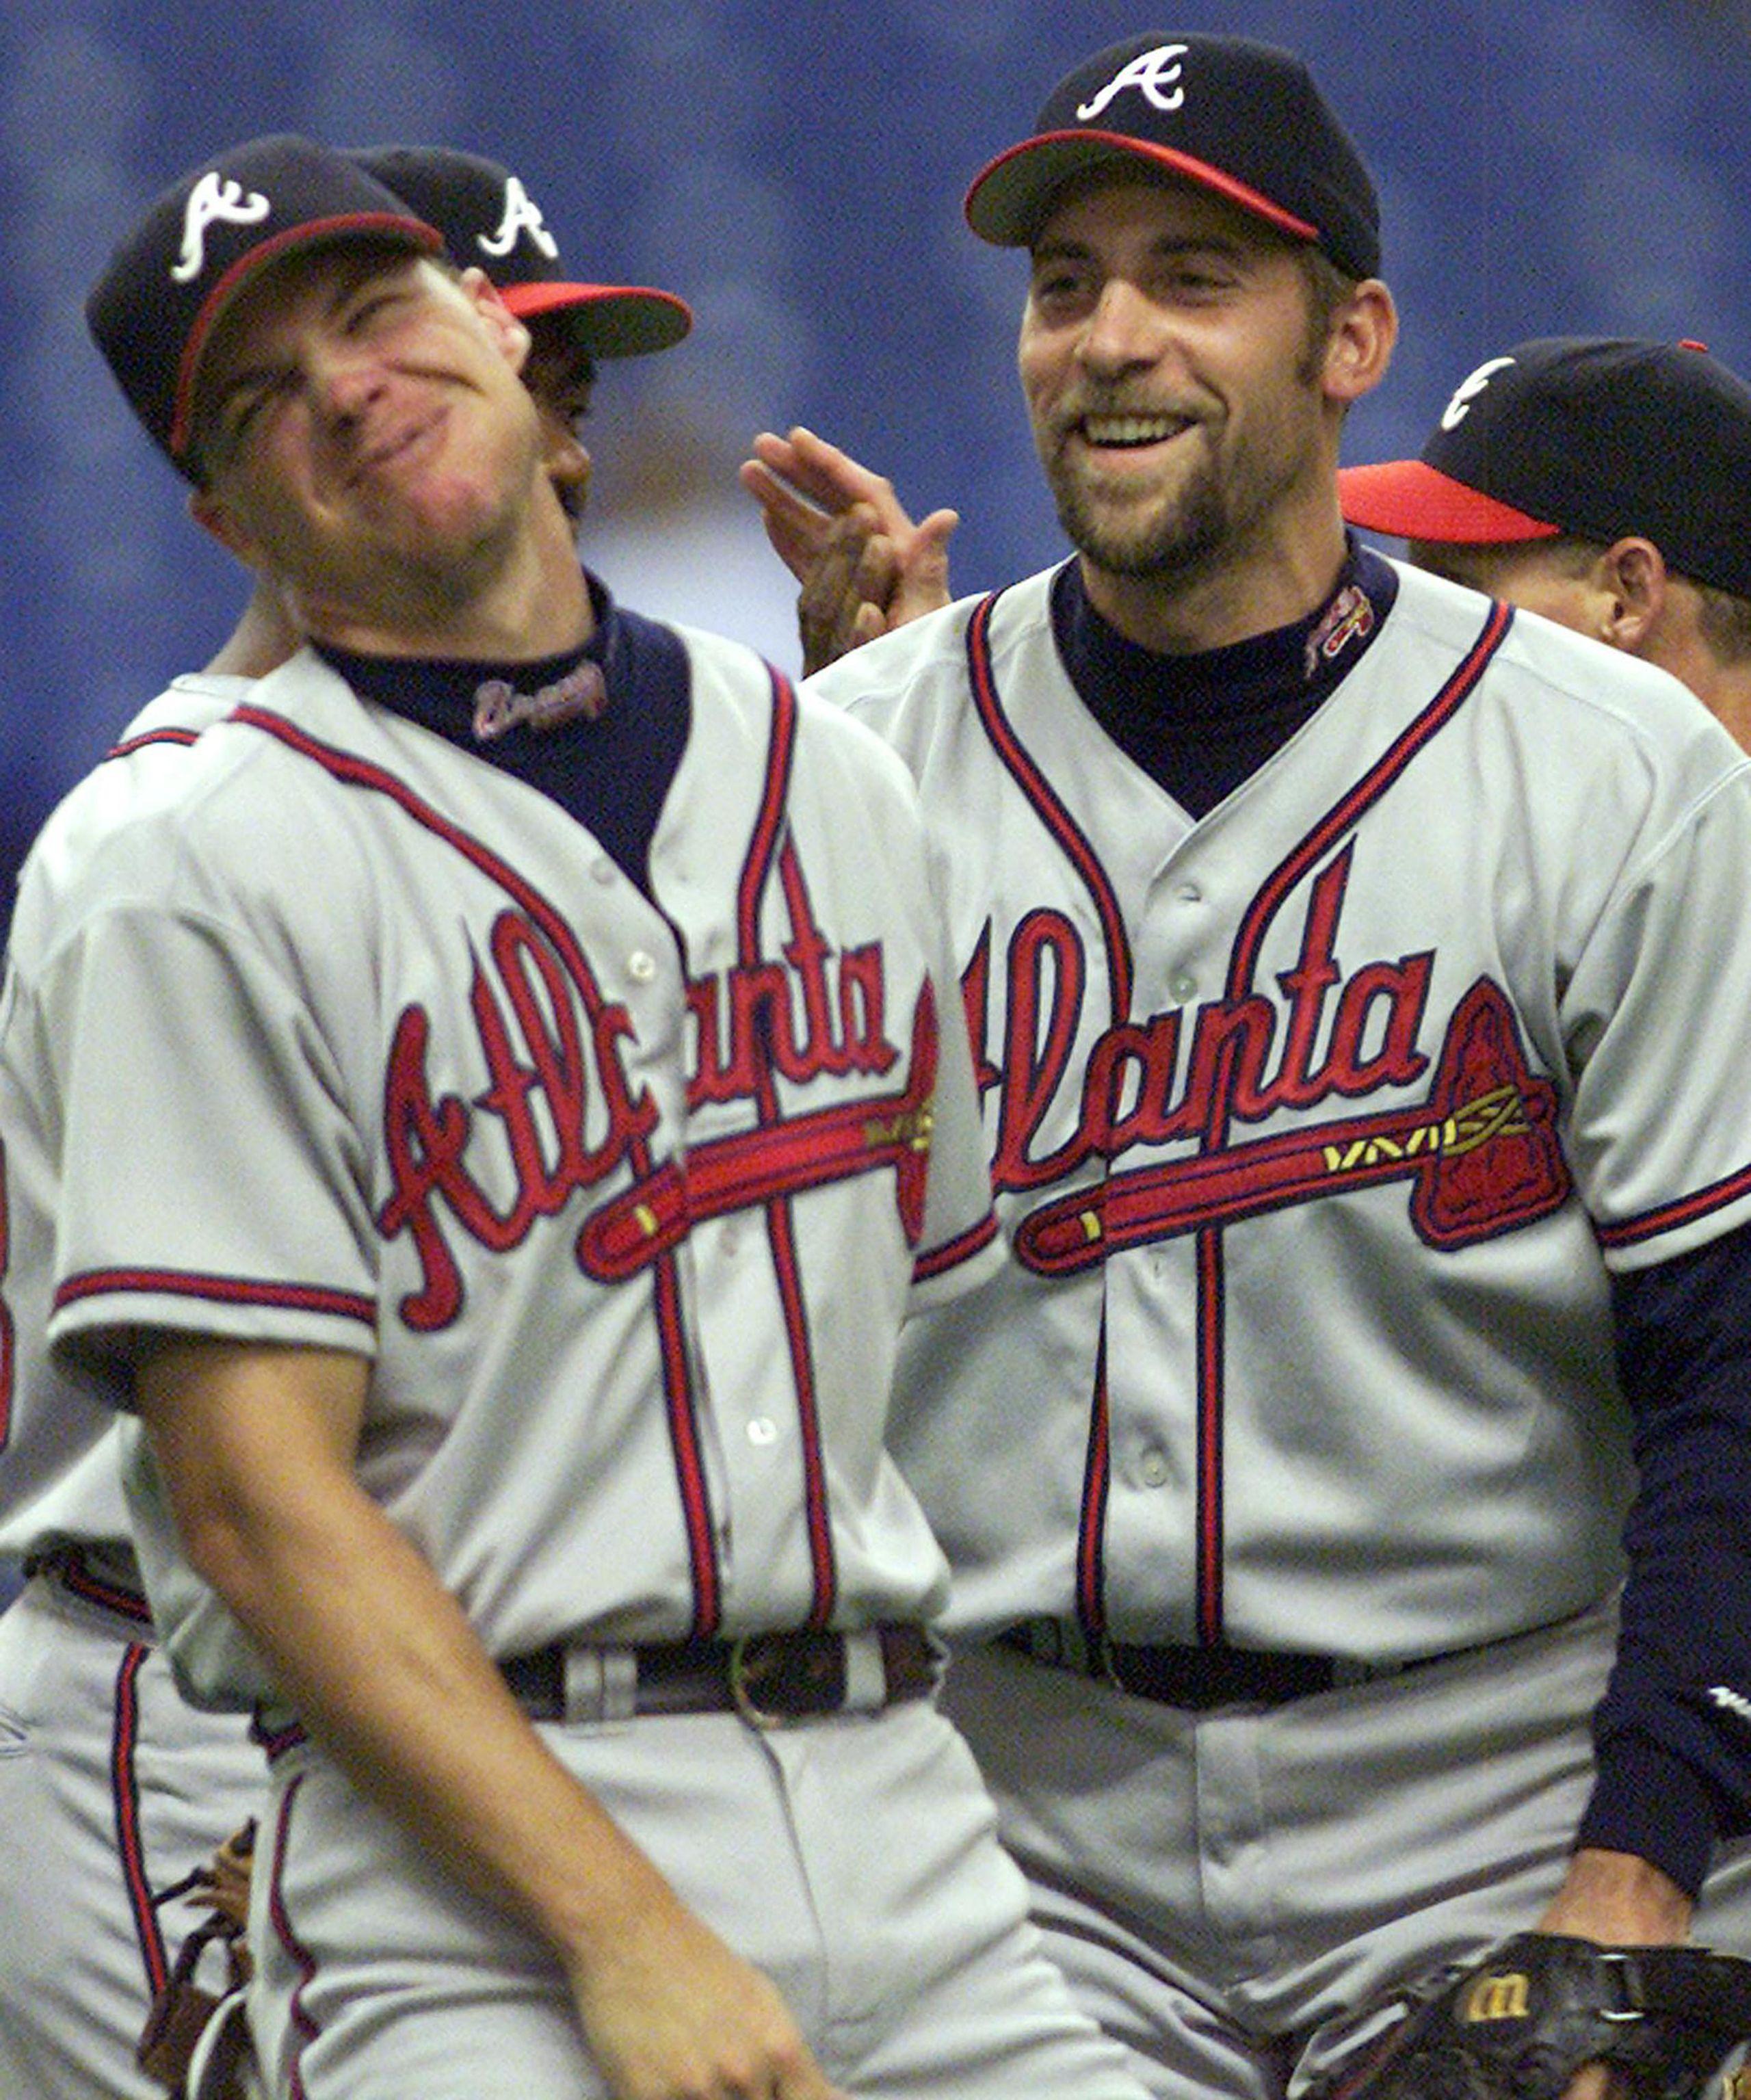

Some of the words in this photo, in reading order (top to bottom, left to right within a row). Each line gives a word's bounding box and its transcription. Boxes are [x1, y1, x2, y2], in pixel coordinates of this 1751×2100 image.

[1077, 44, 1189, 120] A
[171, 171, 271, 283] A
[479, 176, 559, 258] A
